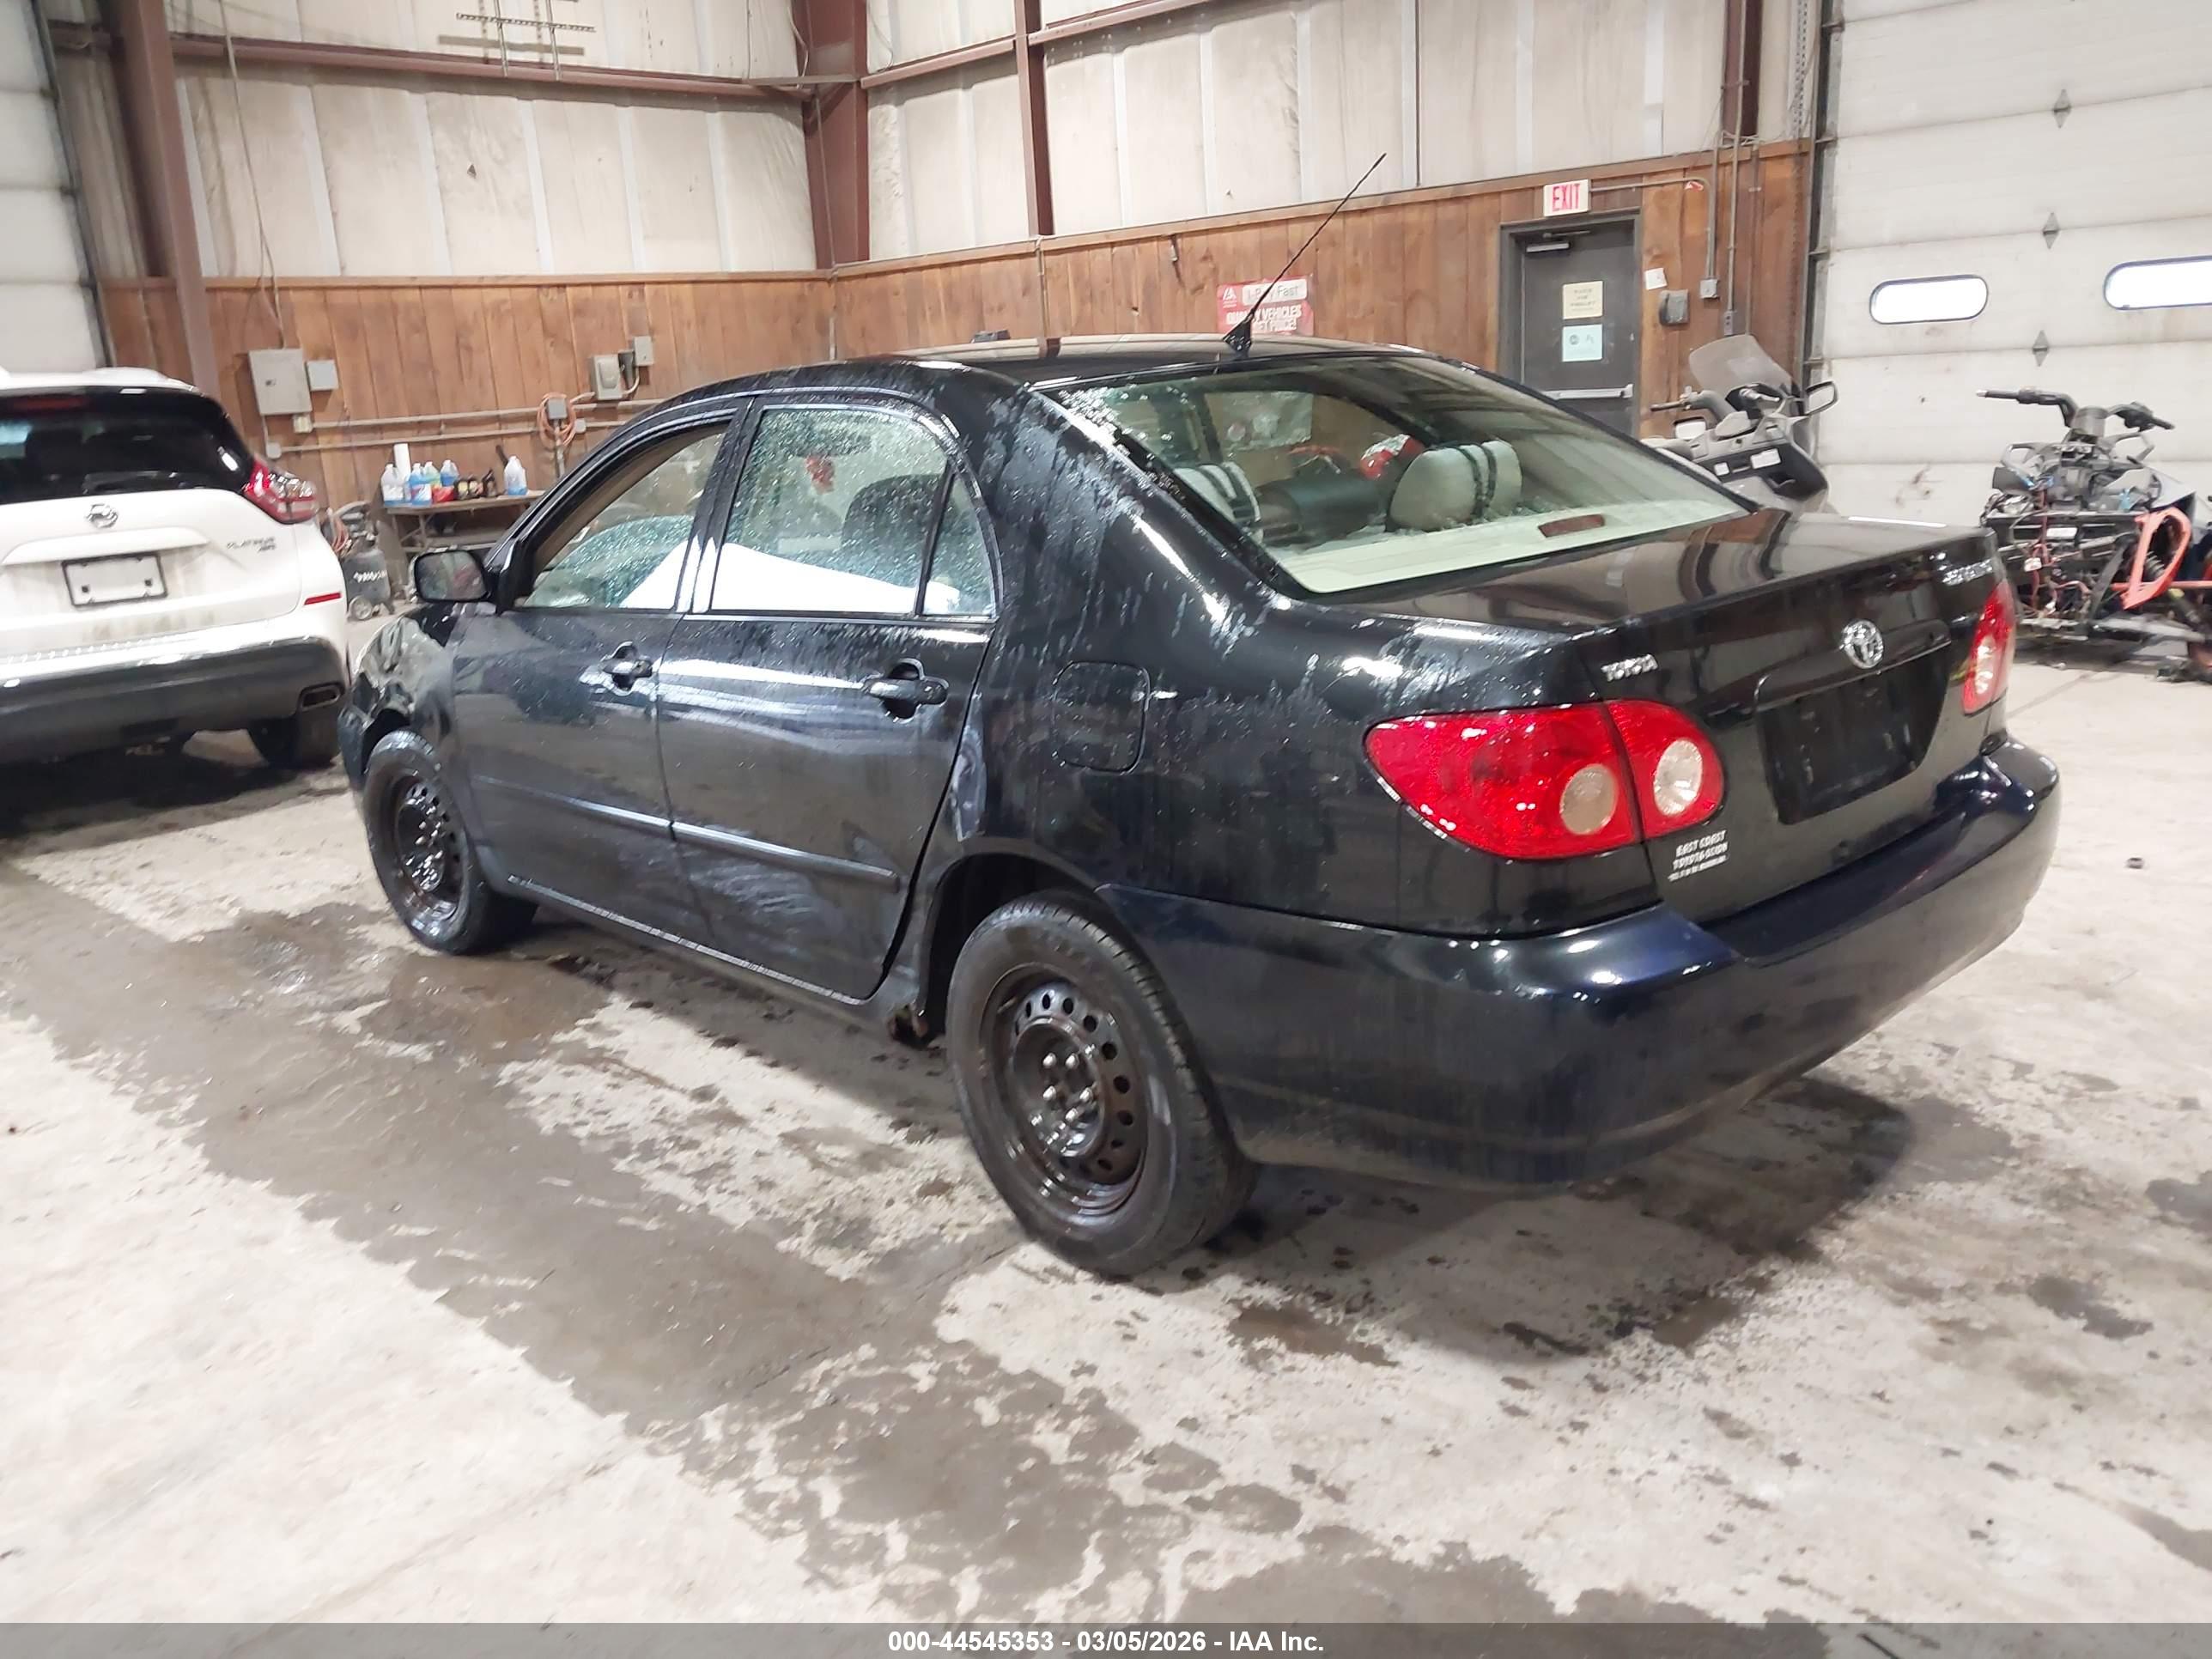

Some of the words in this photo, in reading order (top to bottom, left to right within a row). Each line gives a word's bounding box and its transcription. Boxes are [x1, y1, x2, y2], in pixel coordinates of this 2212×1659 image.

[1553, 183, 1580, 211] EXIT
[1277, 284, 1299, 297] Fast
[1261, 304, 1303, 321] VEHICLES
[1601, 653, 1658, 682] TOYOTA
